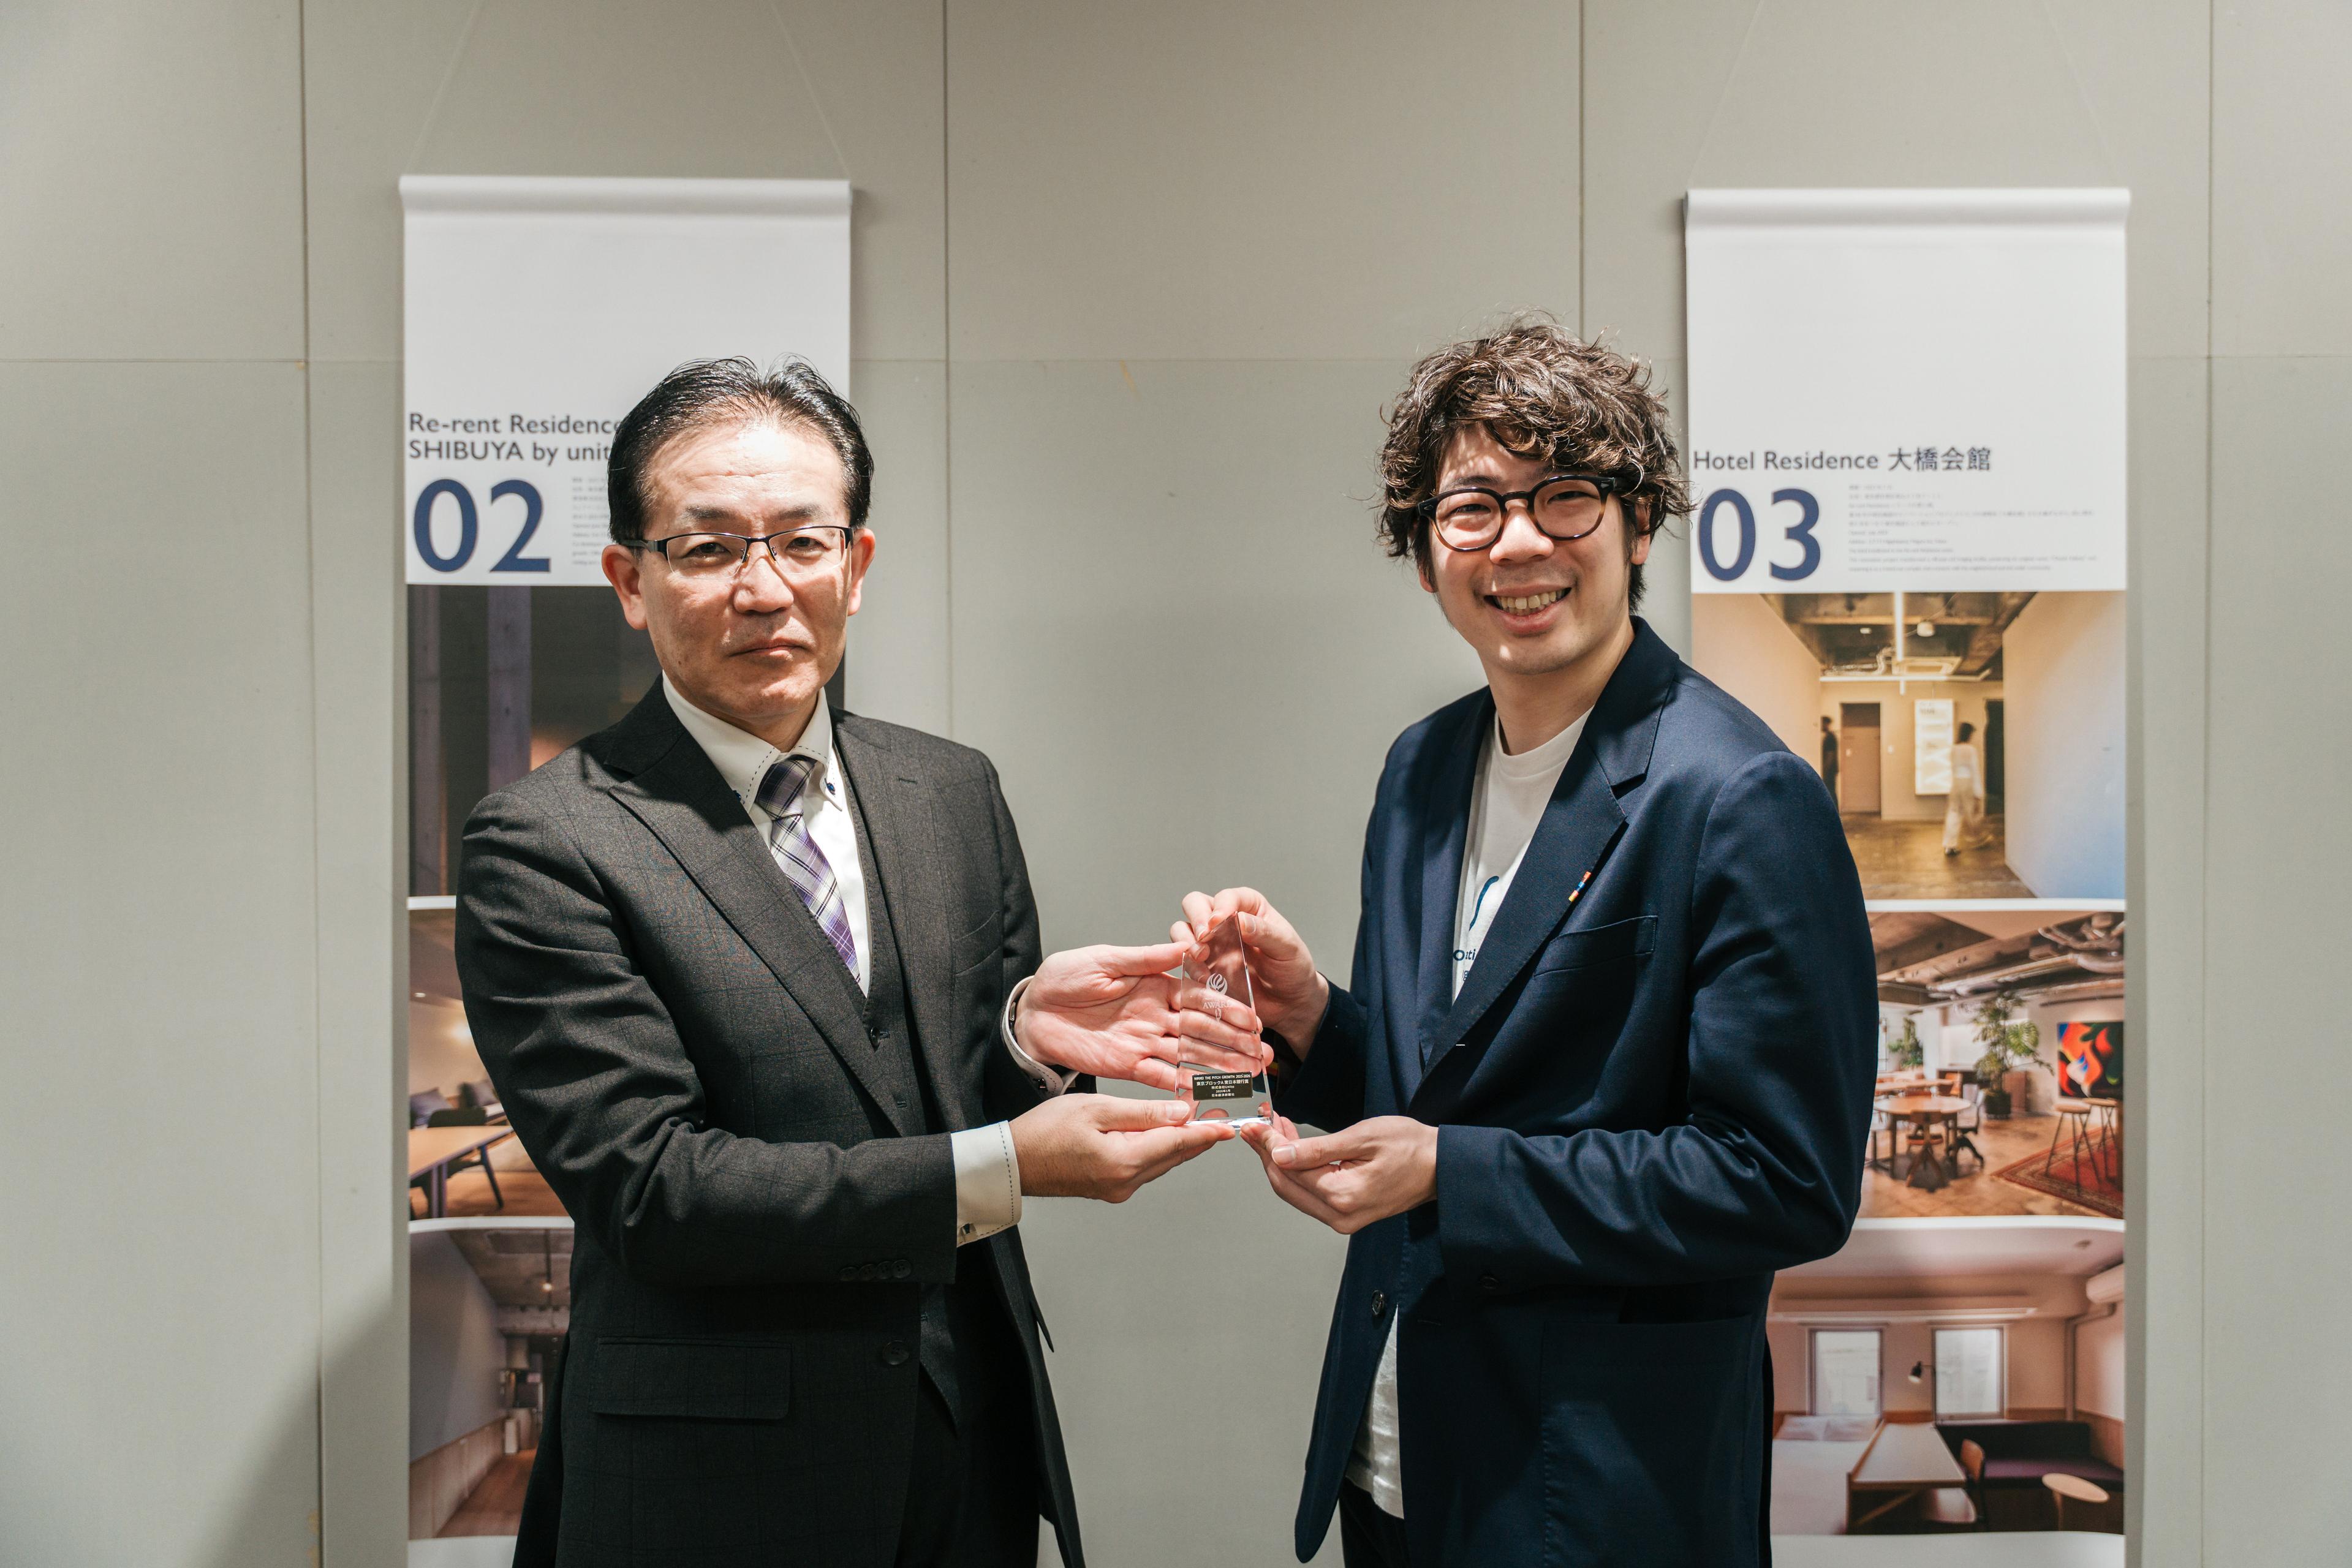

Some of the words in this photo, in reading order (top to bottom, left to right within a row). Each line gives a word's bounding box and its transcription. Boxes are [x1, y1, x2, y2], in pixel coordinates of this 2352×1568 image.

[409, 413, 501, 434] Re-rent
[410, 439, 524, 460] SHIBUYA
[532, 442, 559, 467] by
[1693, 451, 1755, 470] Hotel
[1764, 451, 1879, 470] Residence
[1888, 447, 1992, 472] 大橋会館
[414, 478, 551, 573] 02
[1698, 488, 1821, 581] 03
